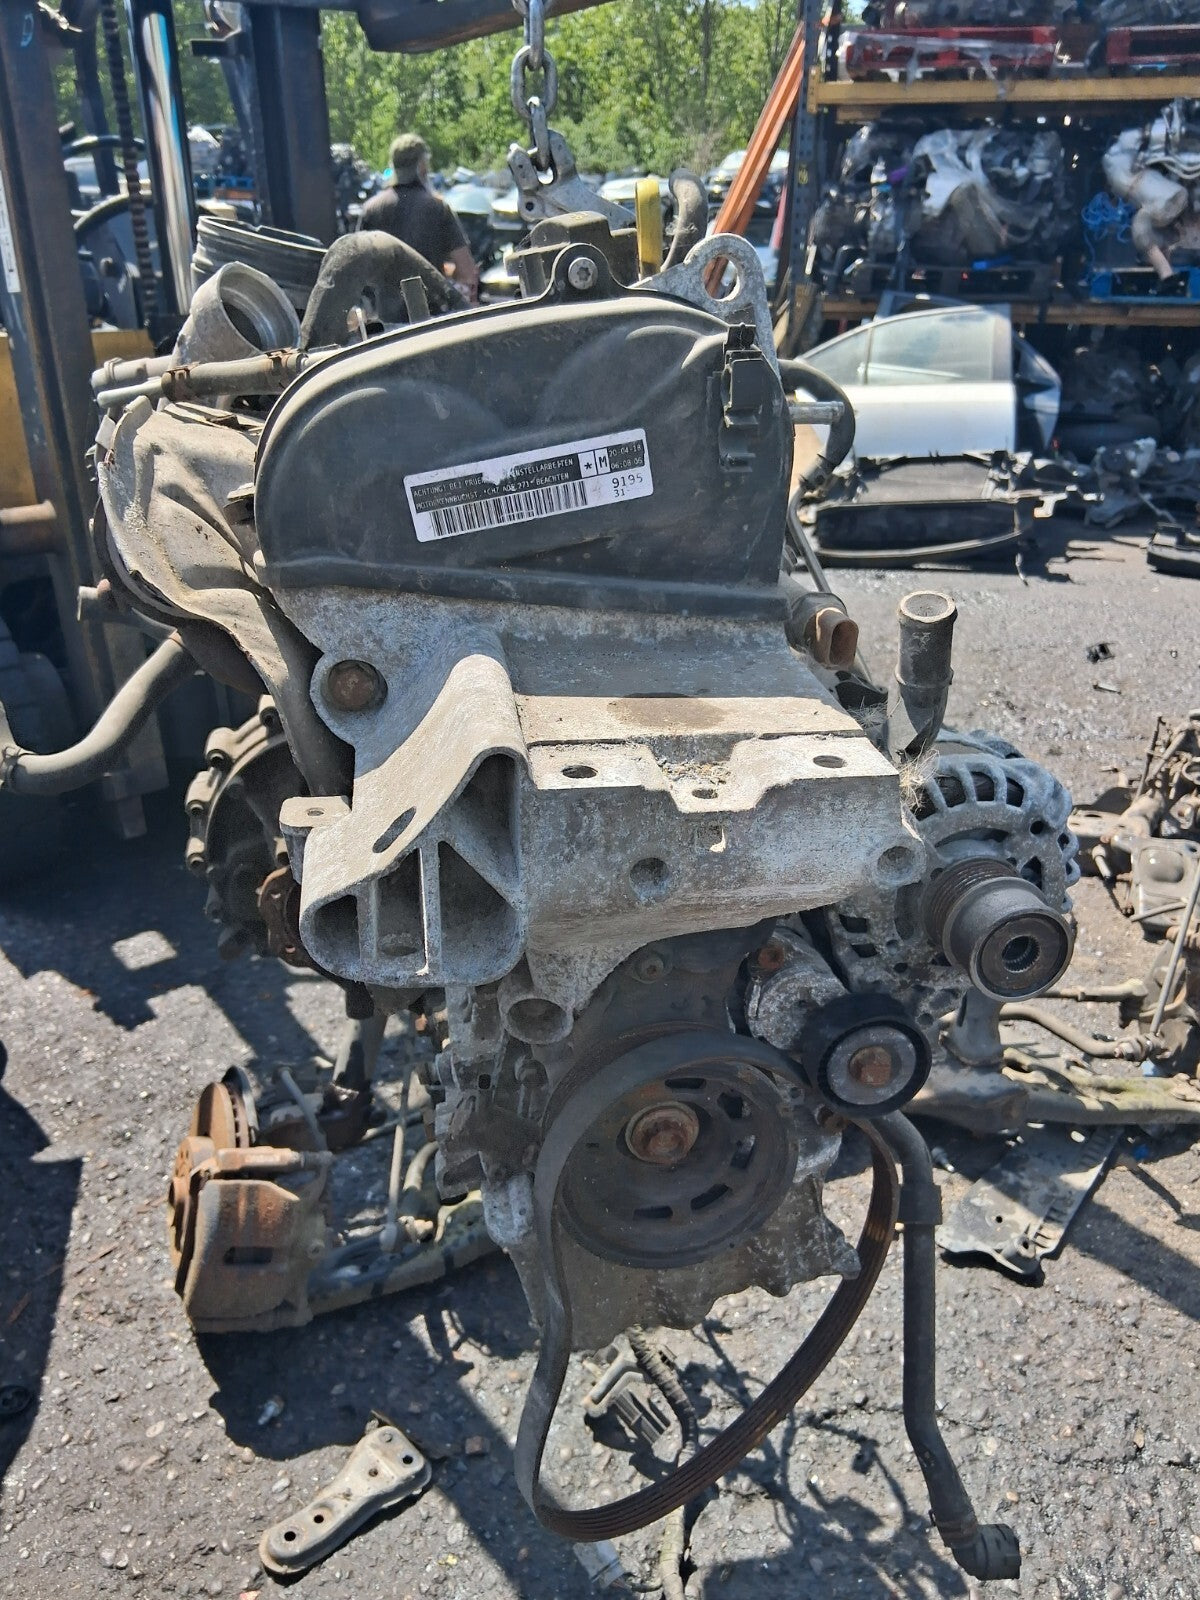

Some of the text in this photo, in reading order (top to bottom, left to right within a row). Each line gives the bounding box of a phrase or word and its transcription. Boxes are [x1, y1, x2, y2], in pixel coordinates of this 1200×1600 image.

[598, 456, 607, 468] M
[465, 478, 486, 486] PRUE
[536, 472, 569, 485] BEACHTEN
